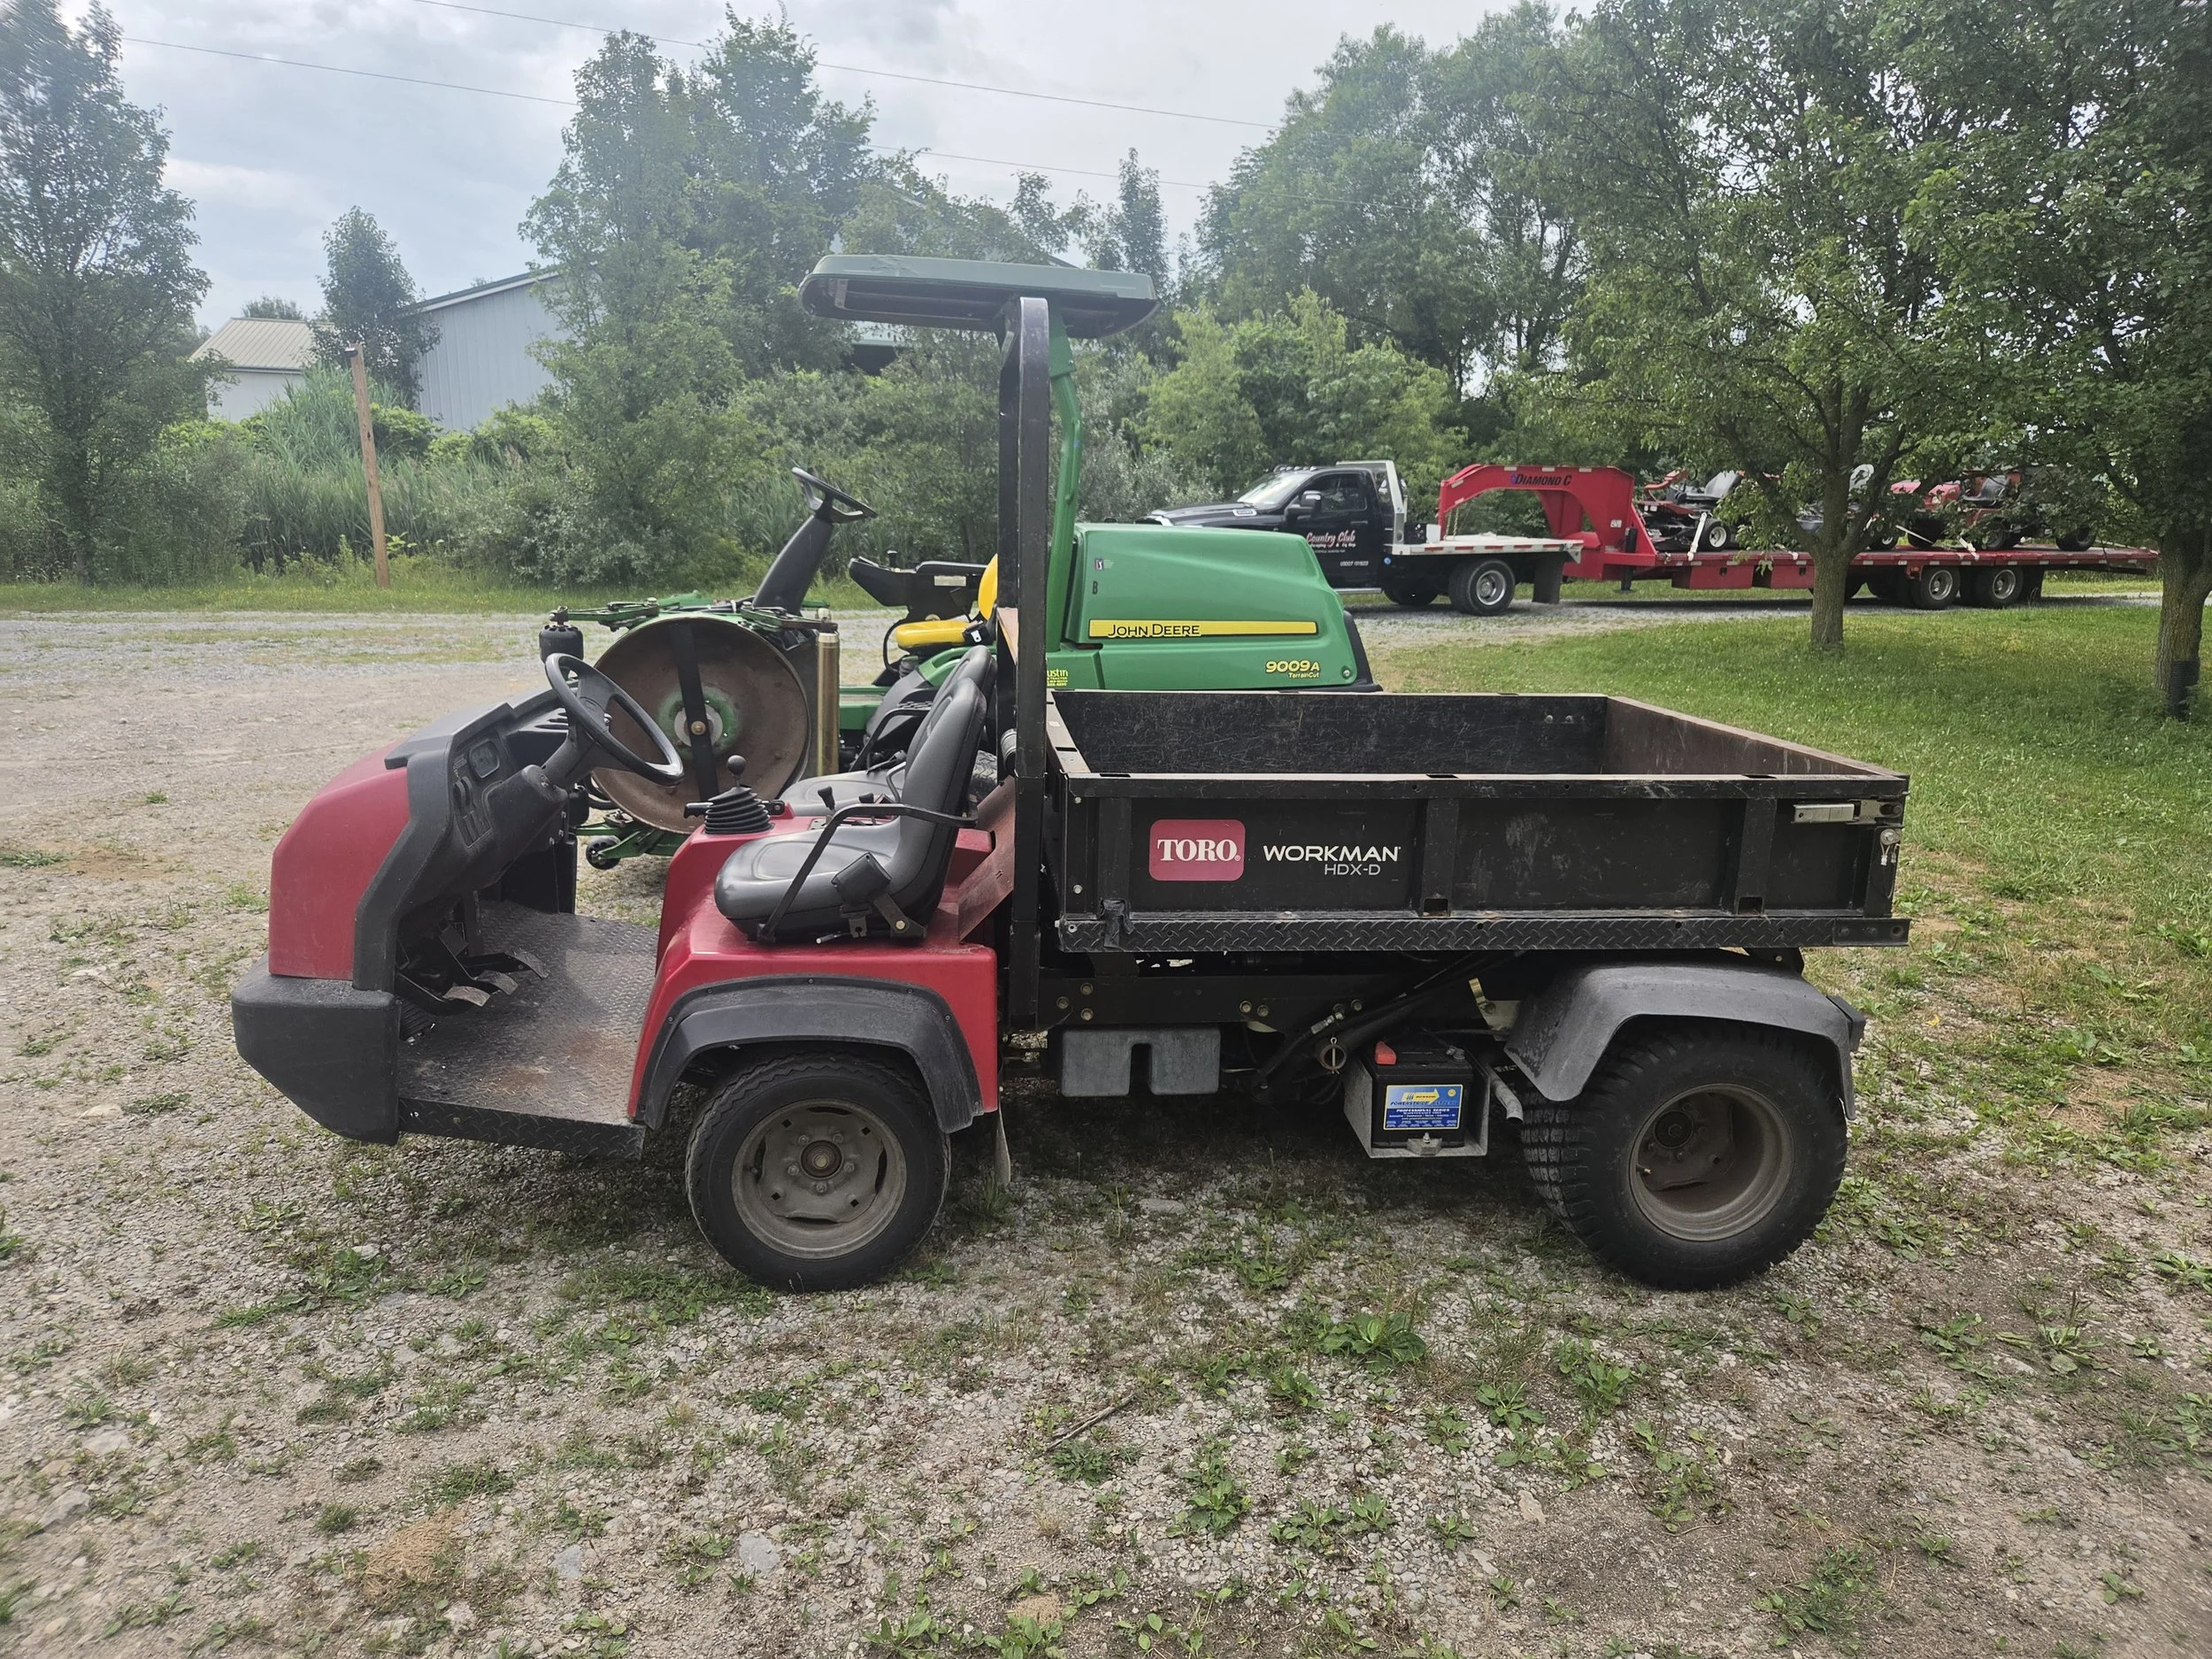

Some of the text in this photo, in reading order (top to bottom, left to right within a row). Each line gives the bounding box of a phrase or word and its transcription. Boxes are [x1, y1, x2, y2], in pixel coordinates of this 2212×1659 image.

[1515, 474, 1572, 486] DIAMOND C
[1306, 529, 1356, 548] Country Club
[1108, 624, 1200, 636] JOHN DEERE
[1157, 839, 1399, 862] TORO WORKMAN
[1324, 864, 1381, 876] HDX-D
